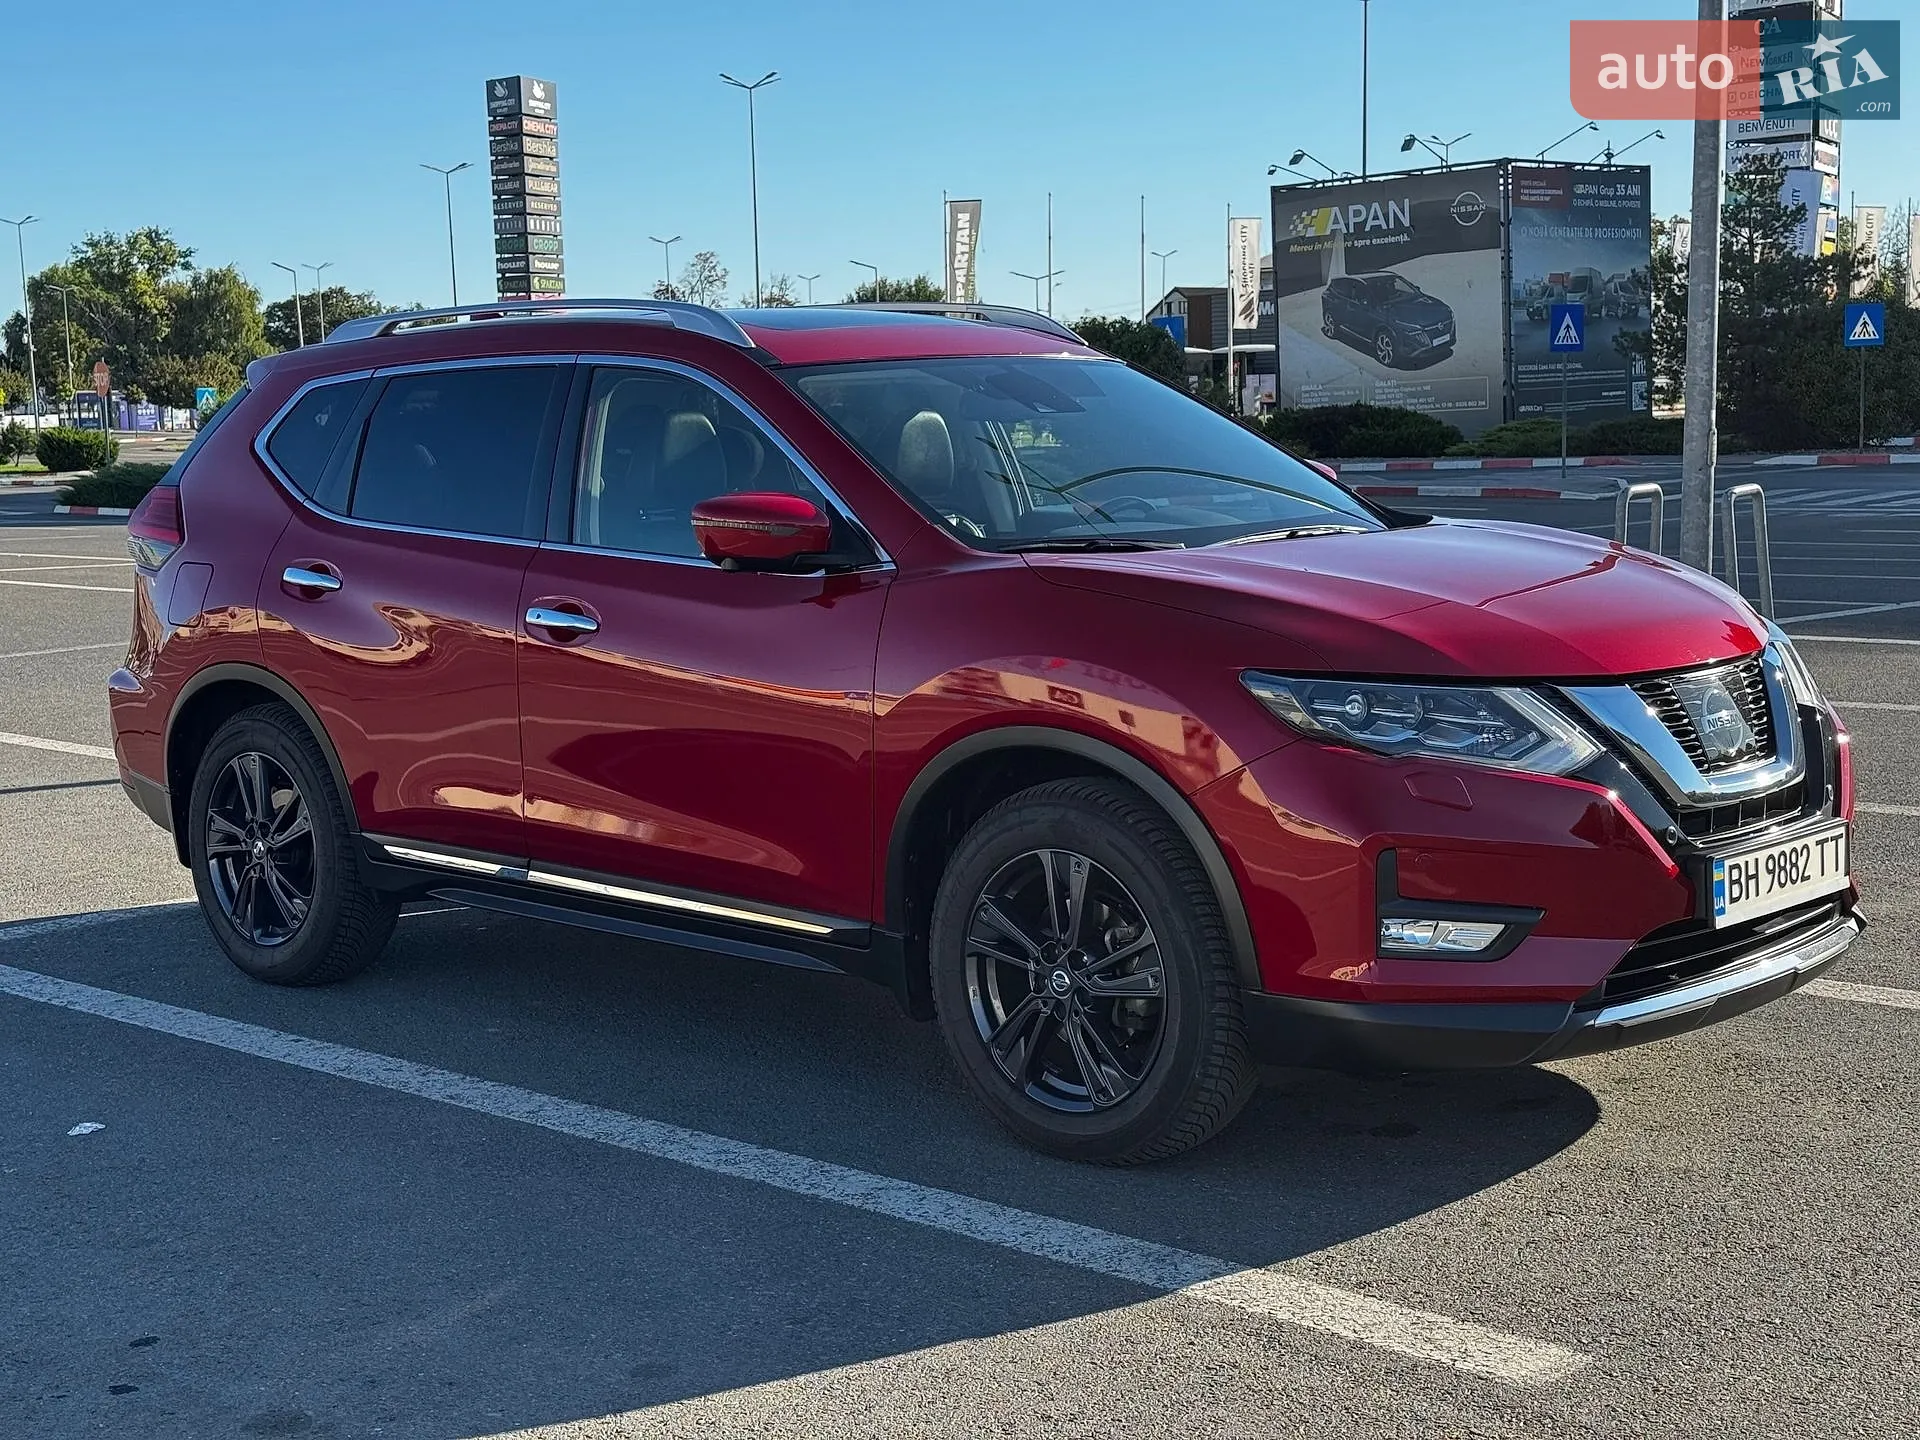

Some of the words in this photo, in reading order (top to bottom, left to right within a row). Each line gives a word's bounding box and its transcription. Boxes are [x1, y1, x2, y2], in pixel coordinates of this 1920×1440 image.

[507, 121, 518, 130] CITY
[545, 123, 557, 135] CITY
[491, 140, 518, 153] Bershka
[526, 138, 556, 154] Bershka
[1616, 184, 1625, 195] 35
[1626, 184, 1641, 196] ANI
[1791, 188, 1800, 206] CITY
[1450, 203, 1486, 214] NISSAN
[1327, 198, 1410, 235] APAN
[1865, 212, 1874, 229] CITY
[1240, 224, 1248, 243] CITY
[533, 239, 558, 251] CROPP
[1323, 239, 1352, 250] Mire
[1354, 238, 1371, 248] spre
[497, 261, 525, 269] house
[534, 259, 560, 270] house
[540, 278, 563, 289] SPARTAN
[1728, 857, 1760, 905] BH
[1765, 844, 1811, 894] 9882
[1815, 833, 1845, 877] TT
[1715, 896, 1725, 909] UA
